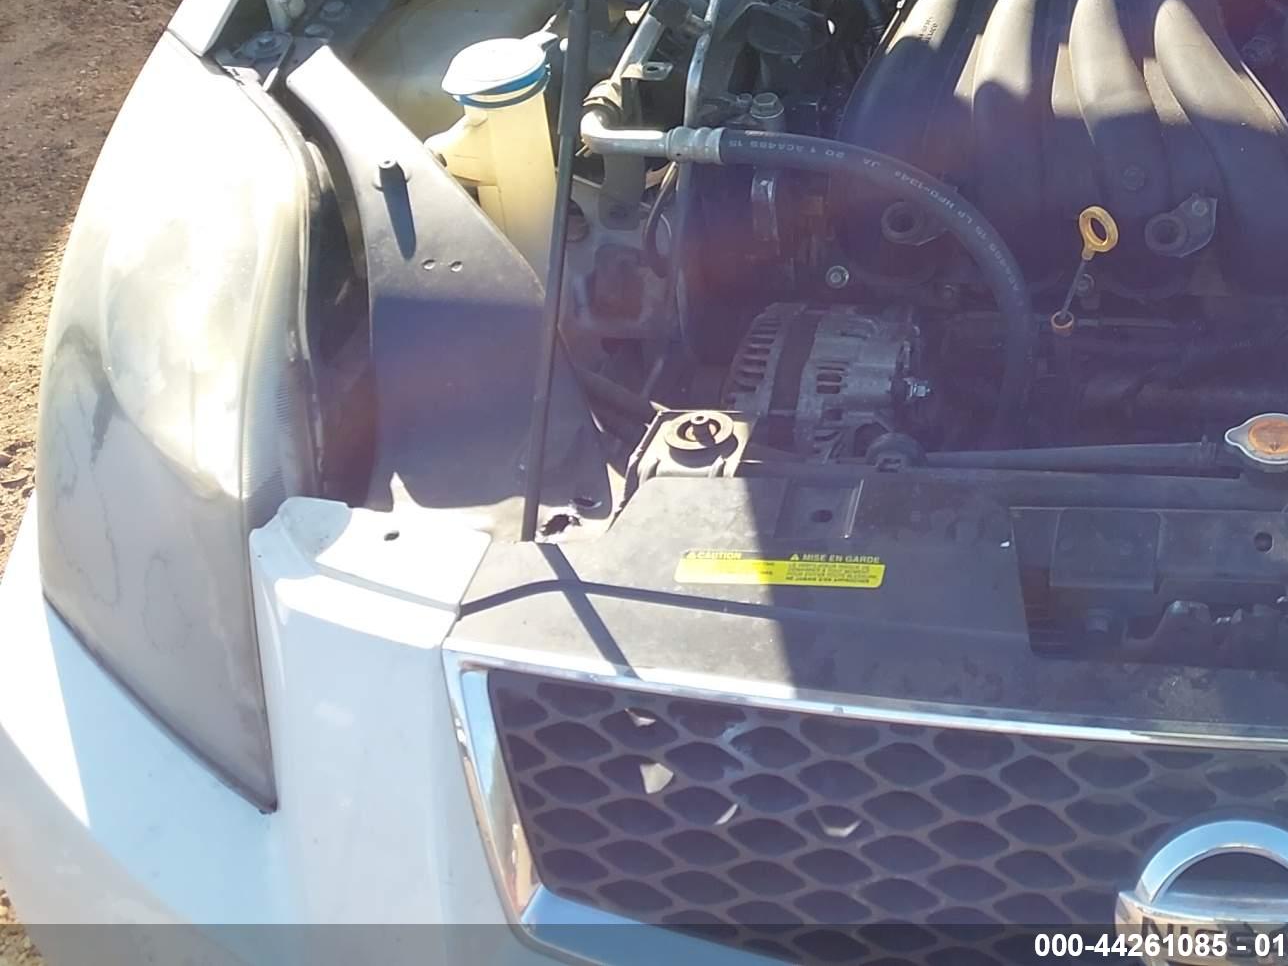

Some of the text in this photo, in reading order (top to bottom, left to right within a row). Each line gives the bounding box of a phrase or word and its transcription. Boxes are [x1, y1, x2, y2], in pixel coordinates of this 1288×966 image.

[696, 550, 742, 560] CAUTION
[802, 553, 881, 564] MISE EN GARDE
